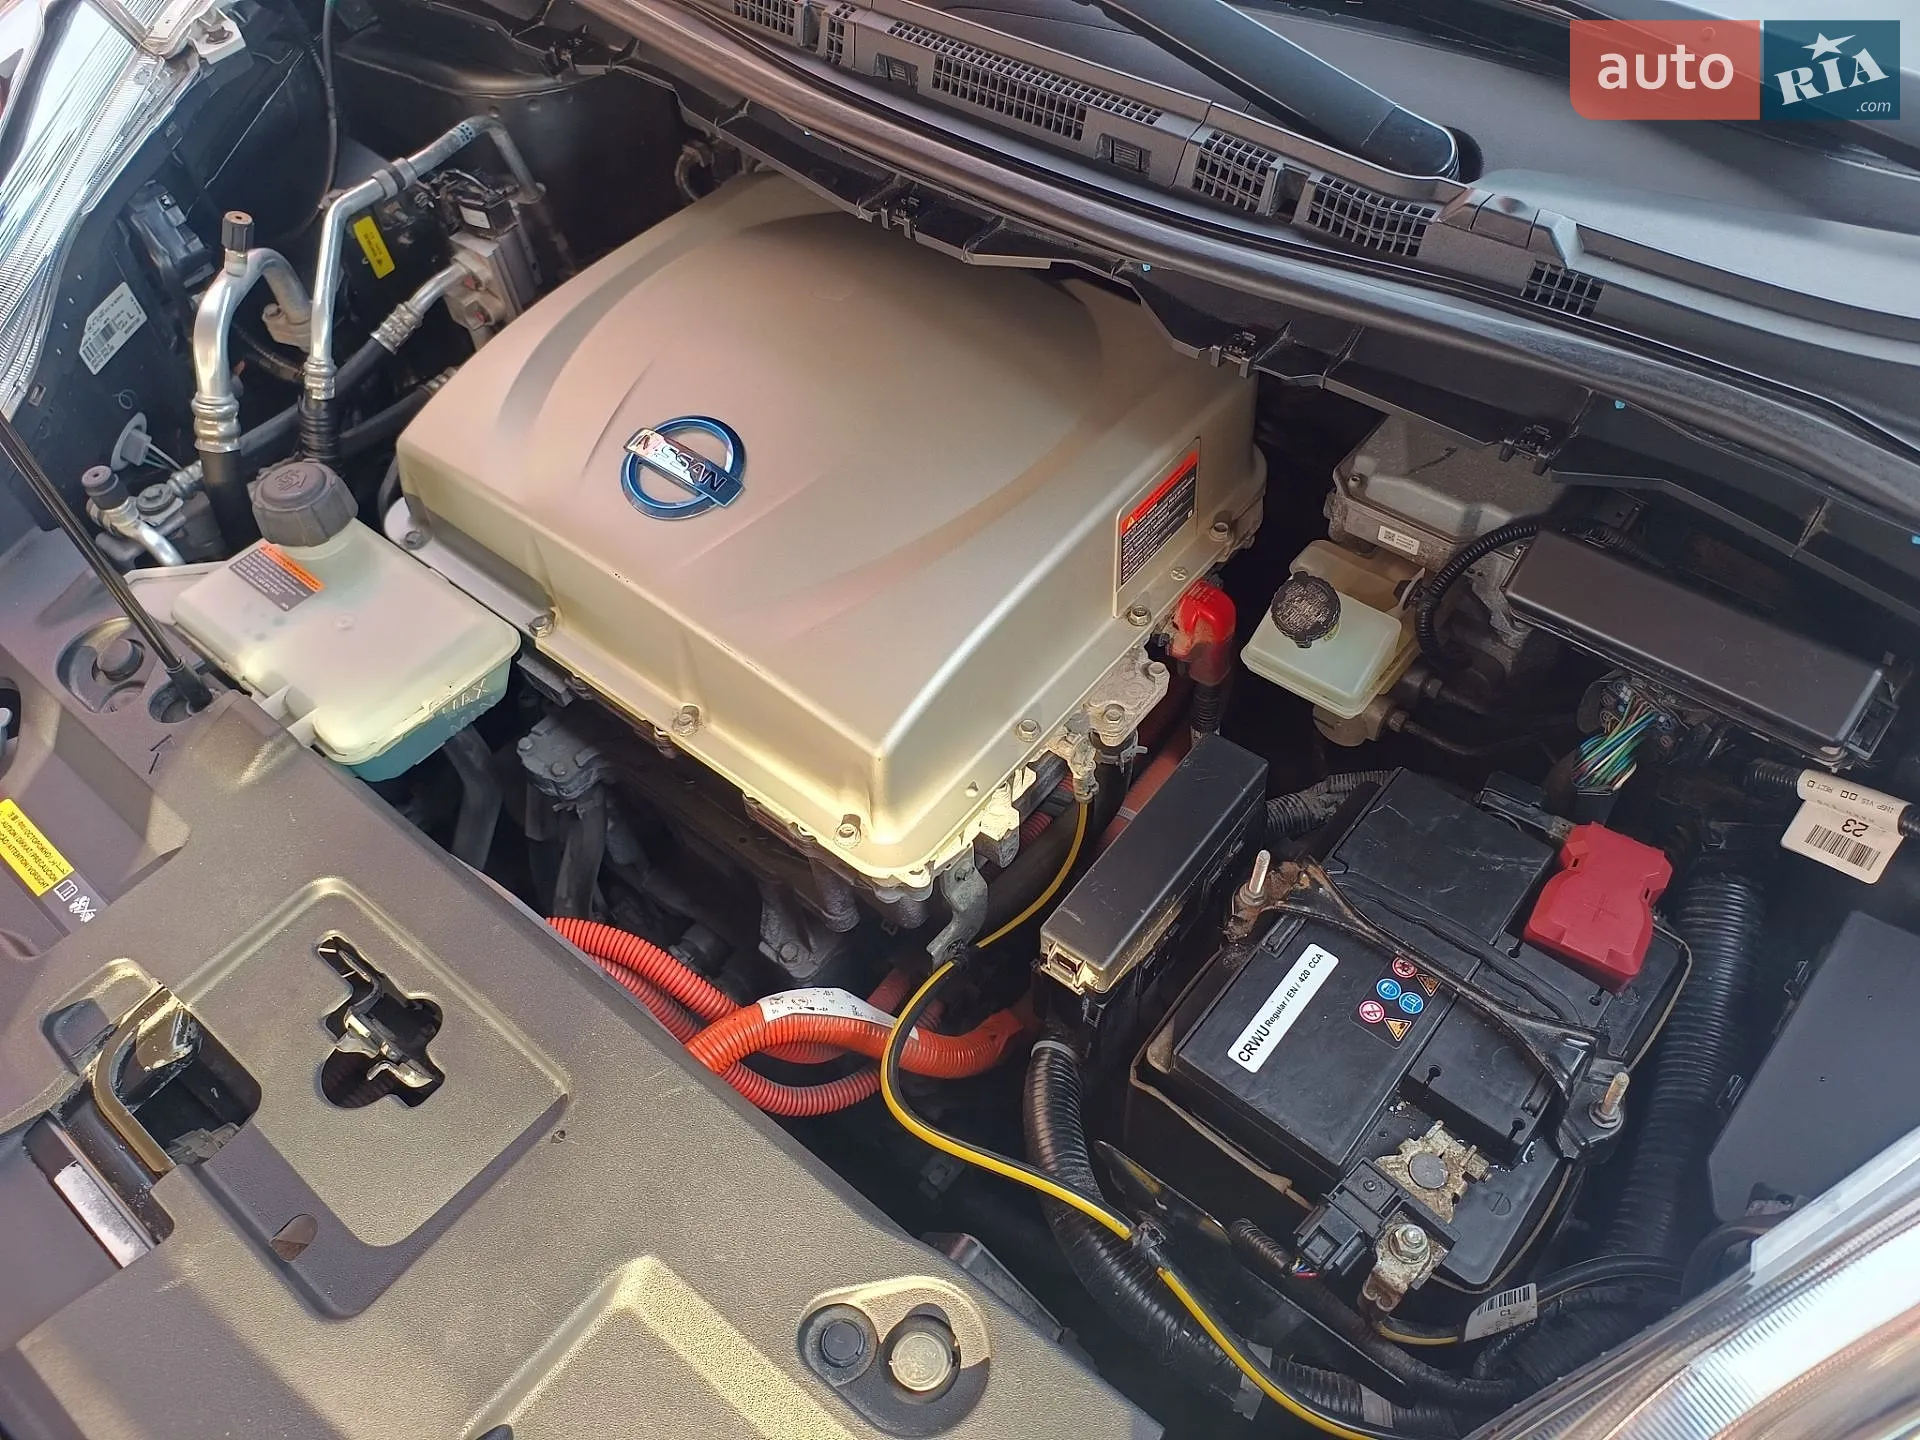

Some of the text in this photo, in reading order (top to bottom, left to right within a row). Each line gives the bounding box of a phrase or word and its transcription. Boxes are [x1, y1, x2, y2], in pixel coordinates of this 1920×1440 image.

[635, 433, 728, 492] NISSAN
[1841, 818, 1870, 837] 23
[1238, 1024, 1270, 1062] CRWU
[1264, 1000, 1288, 1027] Regular
[1286, 986, 1299, 998] EN
[1298, 969, 1311, 984] 420
[1309, 953, 1323, 969] CCA
